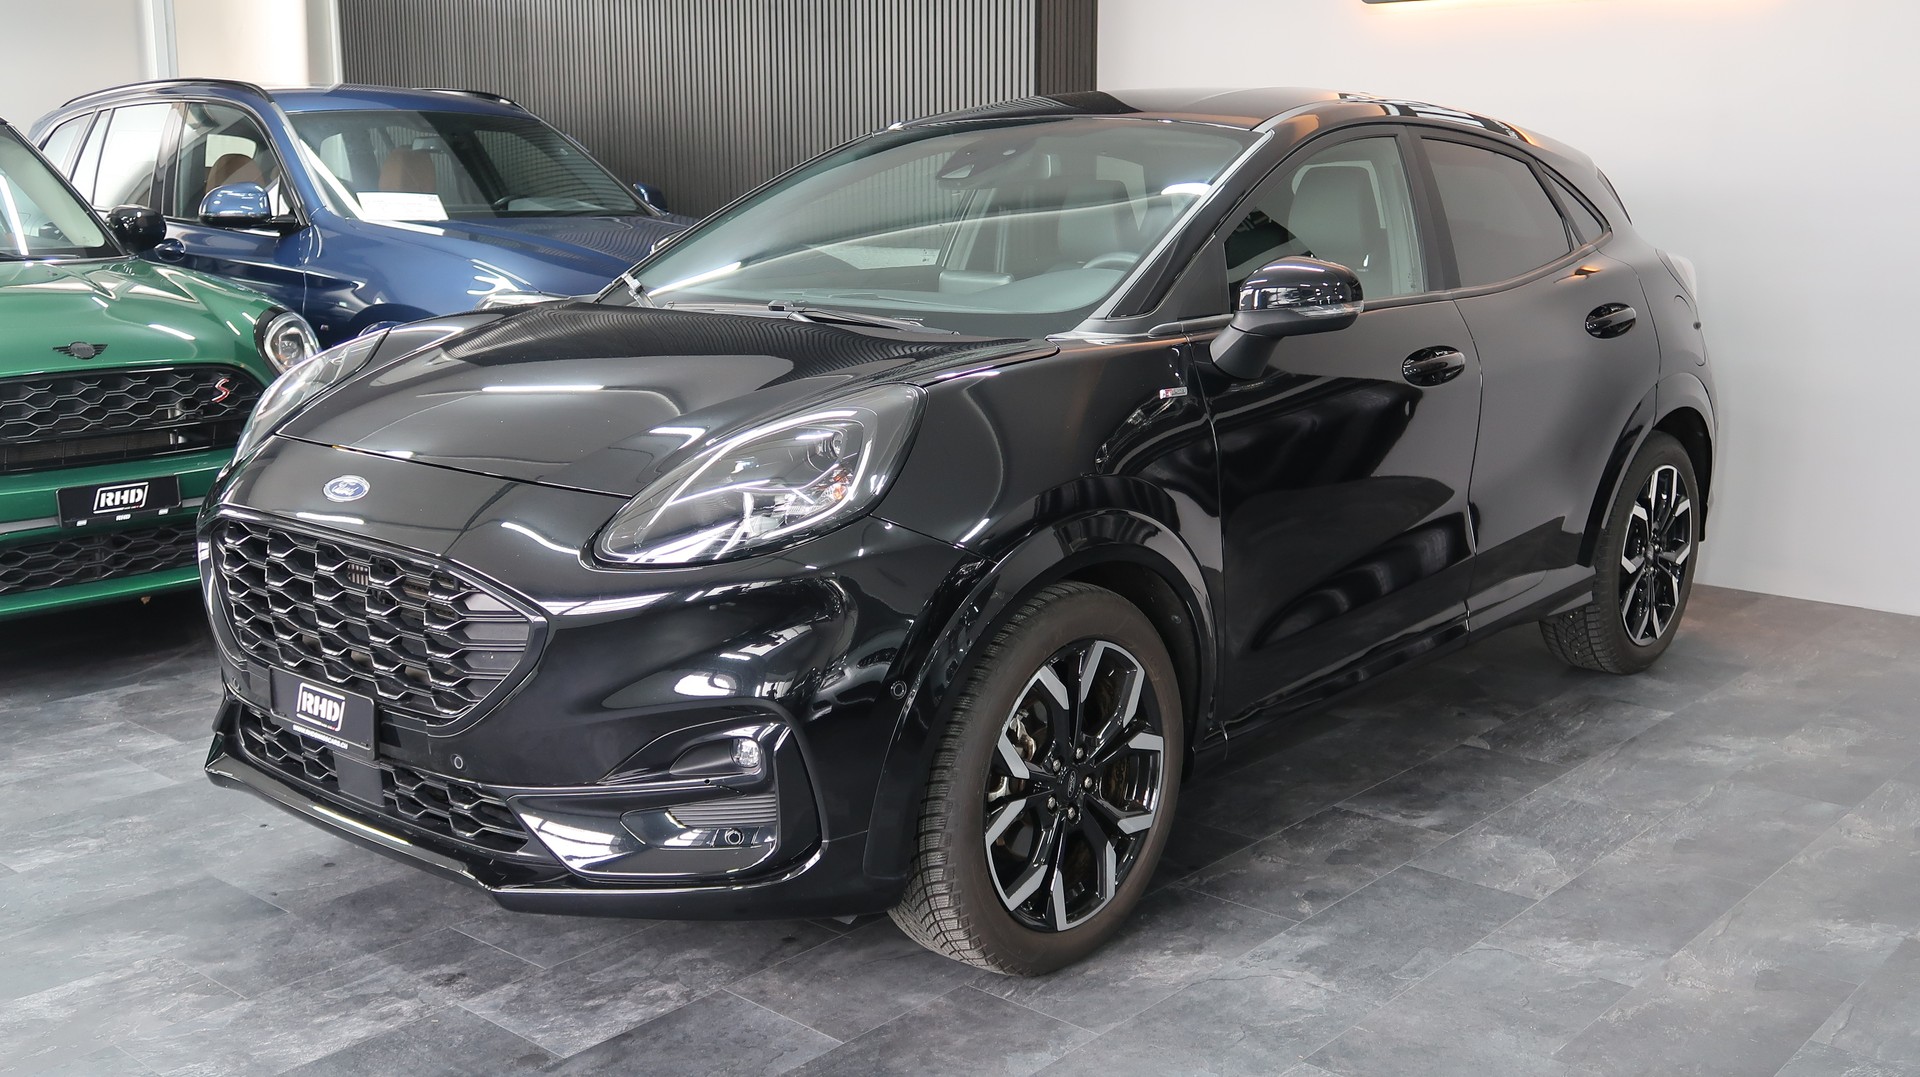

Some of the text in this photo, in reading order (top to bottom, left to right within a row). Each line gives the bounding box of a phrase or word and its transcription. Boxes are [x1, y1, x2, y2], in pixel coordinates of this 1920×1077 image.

[211, 378, 230, 403] S
[99, 488, 144, 508] RHD
[301, 691, 340, 722] RHD
